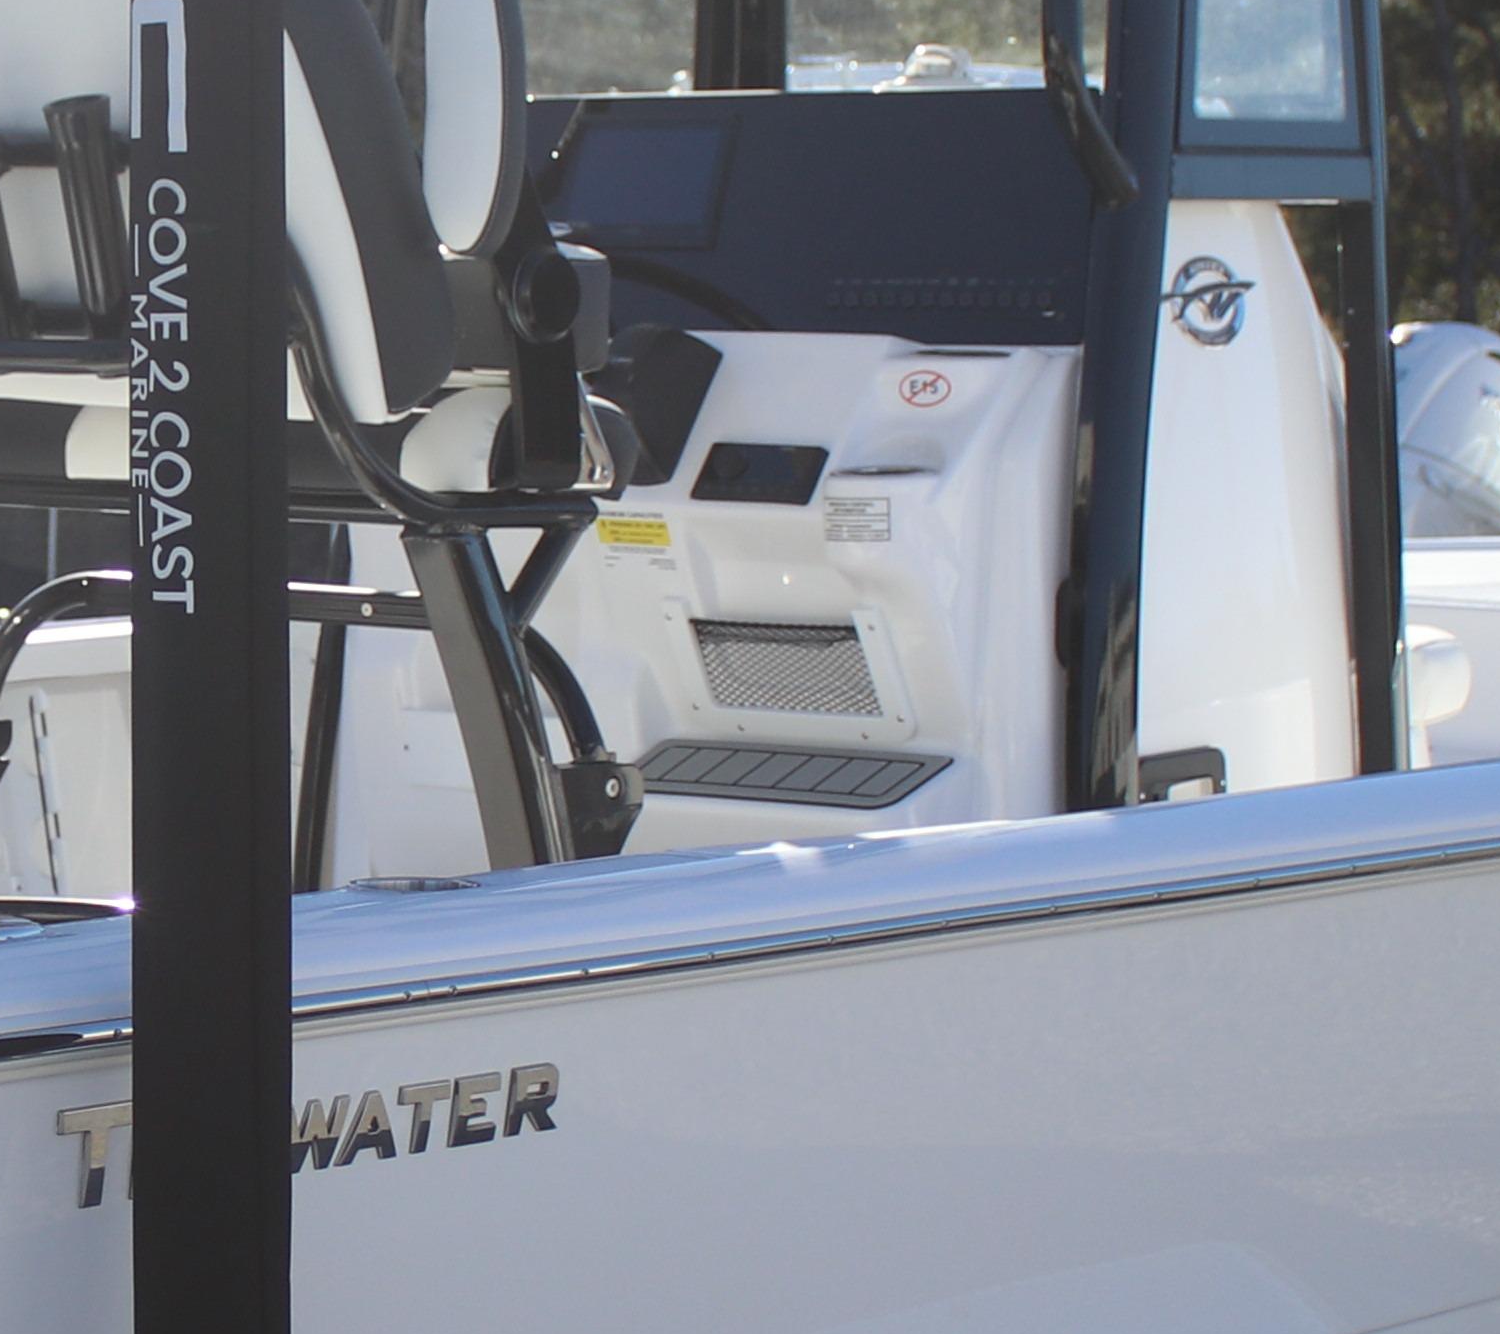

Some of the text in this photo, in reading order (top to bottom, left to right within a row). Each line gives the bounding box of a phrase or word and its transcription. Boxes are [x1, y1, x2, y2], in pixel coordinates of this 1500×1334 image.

[130, 294, 149, 489] MARINE
[148, 178, 195, 614] COVE 2 COAST
[56, 1062, 561, 1208] TWATER
